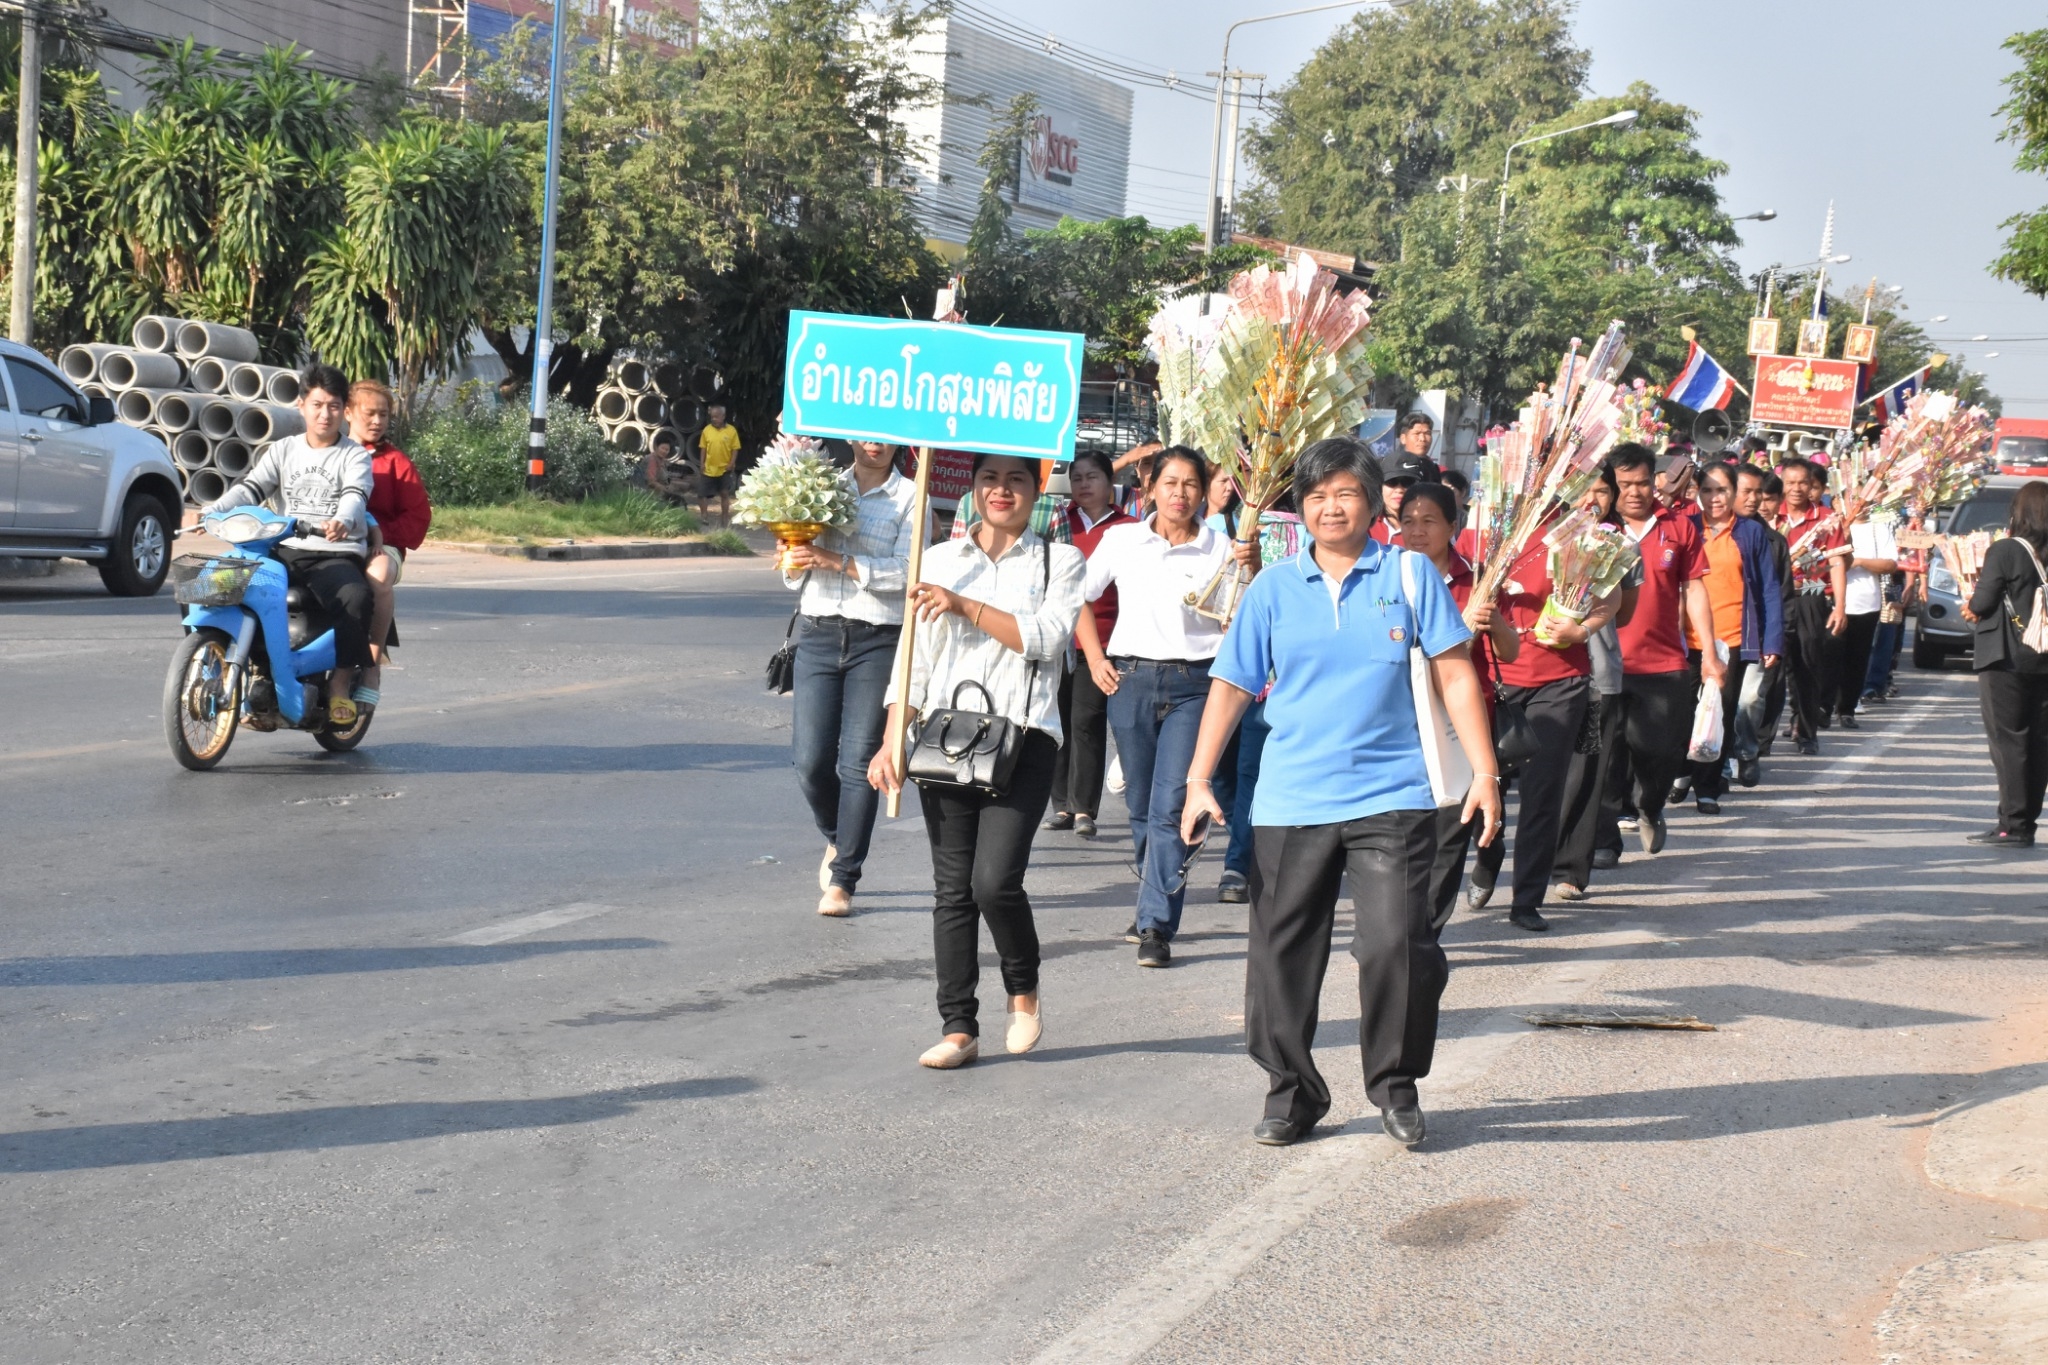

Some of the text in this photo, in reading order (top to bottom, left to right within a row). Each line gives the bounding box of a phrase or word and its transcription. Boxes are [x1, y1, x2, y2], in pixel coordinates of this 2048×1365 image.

[1048, 132, 1079, 174] SCG
[802, 343, 1058, 437] อำเภอโกสุมพิสัย
[289, 470, 301, 486] LOS
